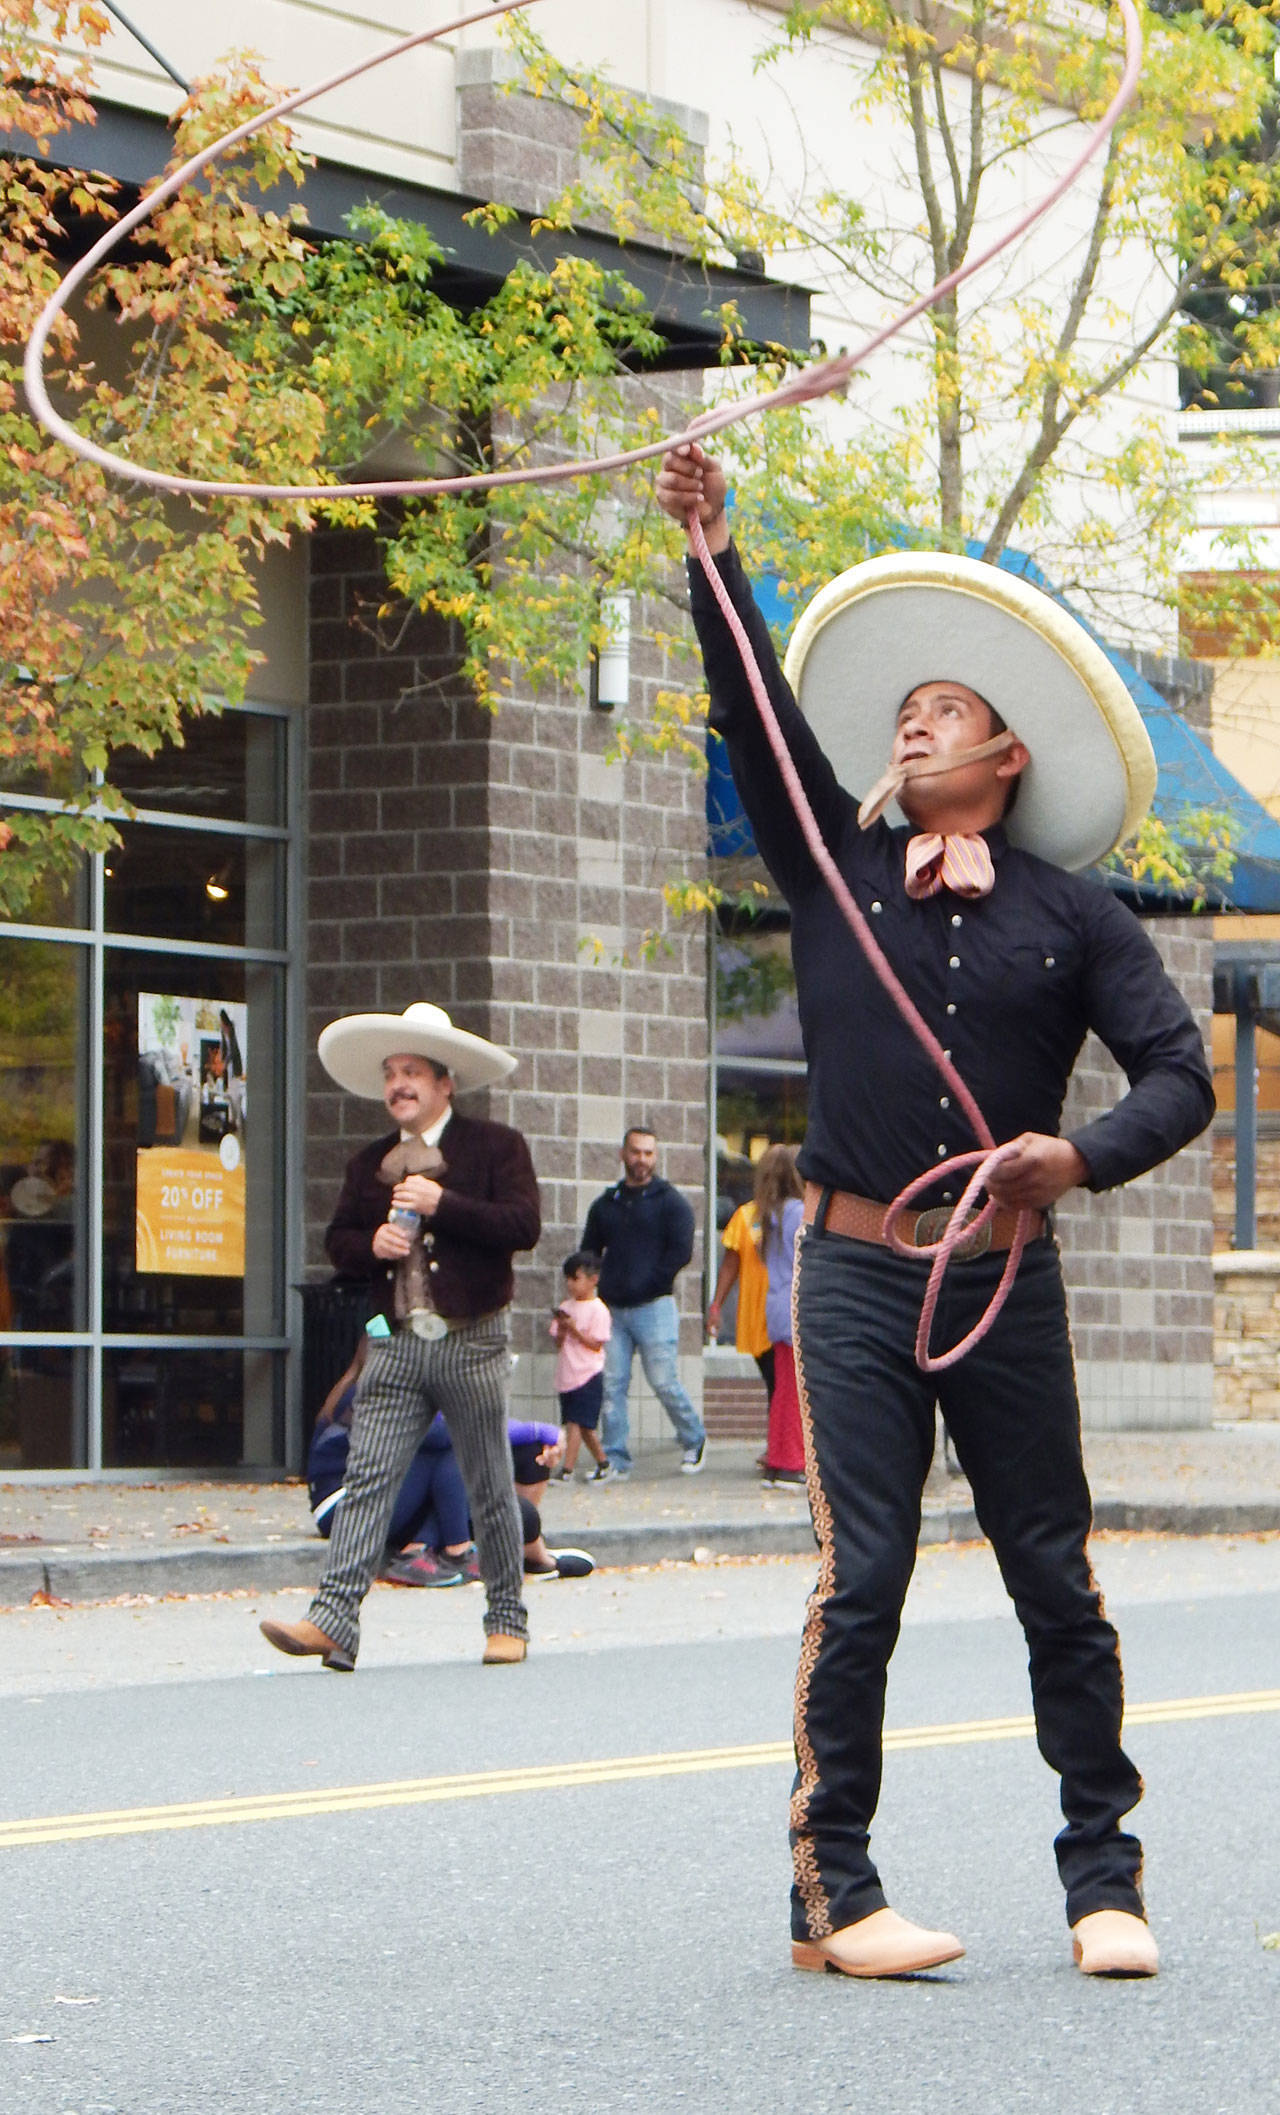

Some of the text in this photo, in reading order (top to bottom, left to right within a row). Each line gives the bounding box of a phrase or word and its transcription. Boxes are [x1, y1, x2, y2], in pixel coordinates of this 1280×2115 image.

[191, 1187, 224, 1210] OFF
[160, 1228, 224, 1244] LIVING ROOM
[165, 1245, 217, 1262] FURNITURE
